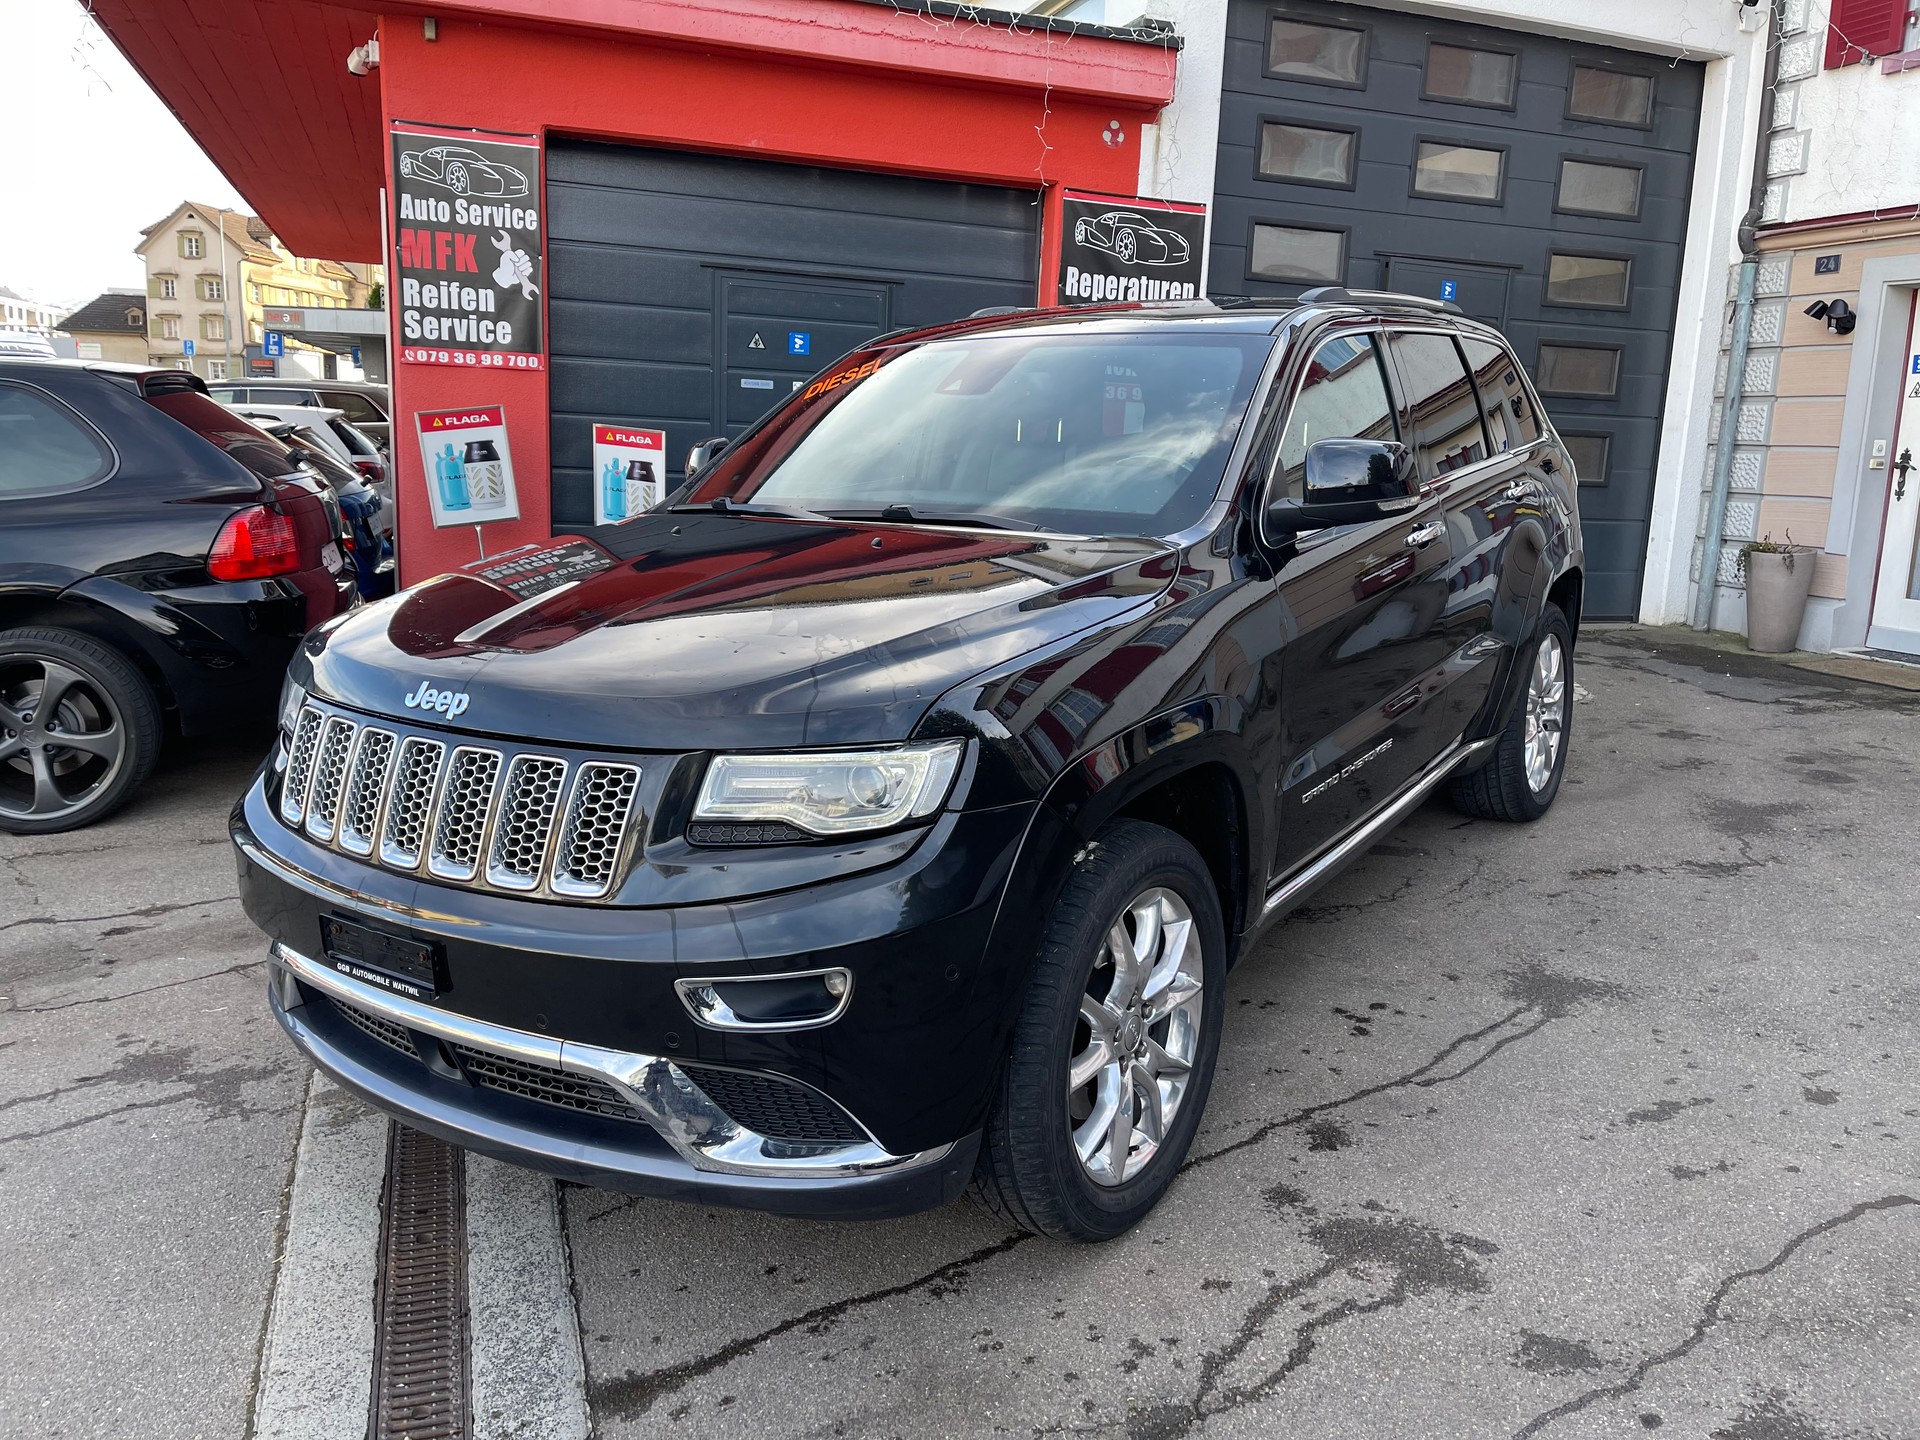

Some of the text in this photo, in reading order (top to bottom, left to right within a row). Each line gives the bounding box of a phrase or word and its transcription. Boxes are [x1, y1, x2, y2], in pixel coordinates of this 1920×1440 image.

[400, 193, 538, 230] Auto Service
[400, 228, 478, 273] MFK
[1820, 257, 1835, 271] 24
[402, 277, 495, 312] Reifen
[1065, 266, 1195, 302] Reperaturen
[269, 333, 279, 345] P
[403, 309, 512, 344] Service
[416, 350, 538, 368] 079 36 98 700
[803, 358, 882, 400] DIESEL
[445, 414, 490, 426] FLAGA
[615, 433, 653, 445] FLAGA
[404, 681, 471, 721] Jeep
[352, 967, 390, 986] AUTOMOBILE
[392, 981, 420, 997] WATTWIL
